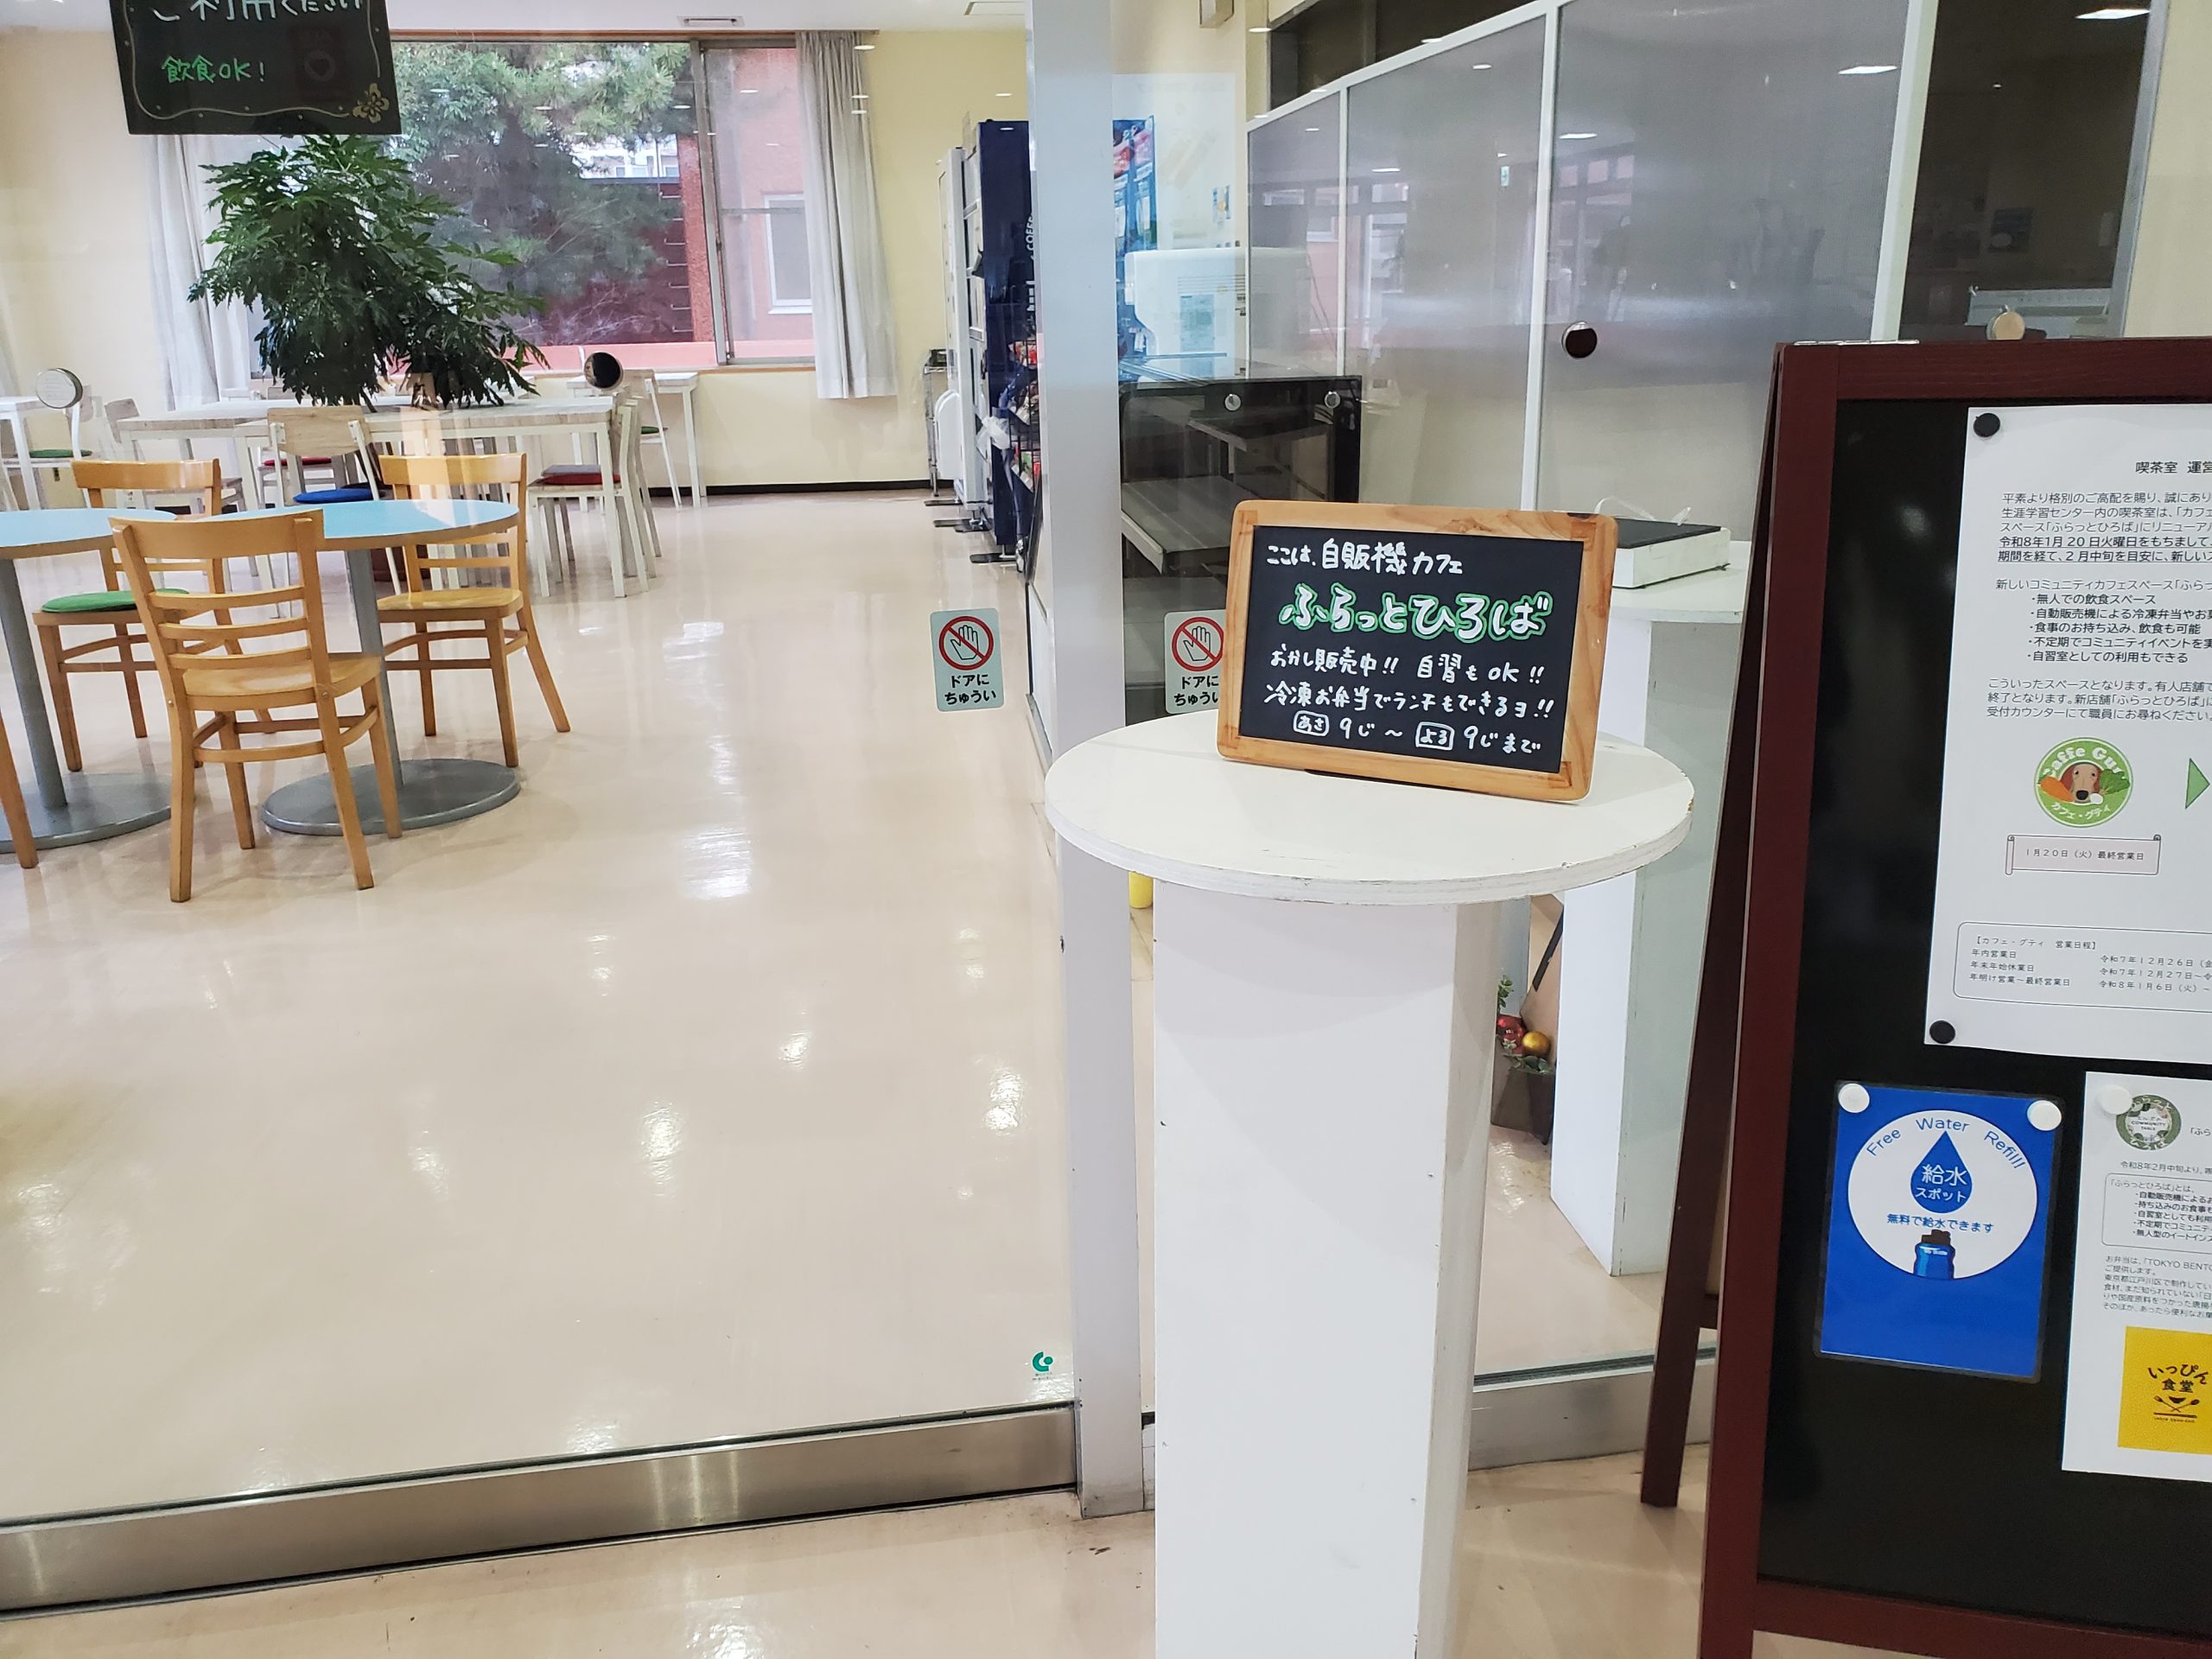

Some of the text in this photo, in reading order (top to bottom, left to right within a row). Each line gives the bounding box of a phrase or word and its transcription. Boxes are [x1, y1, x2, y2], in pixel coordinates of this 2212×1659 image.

[2135, 461, 2212, 474] 喫茶室 運営
[1279, 582, 1553, 643] ふらっとひろば
[950, 673, 990, 689] ドアに
[1182, 675, 1219, 690] ドアに
[944, 690, 997, 706] ちゅうい
[1866, 1116, 2026, 1169] Free Water Refill
[1921, 1163, 1968, 1186] 給水
[1915, 1186, 1967, 1204] スポット
[1887, 1213, 1995, 1234] 無料で給水できます
[2147, 1363, 2209, 1384] いっぴん
[2161, 1378, 2194, 1393] 食堂
